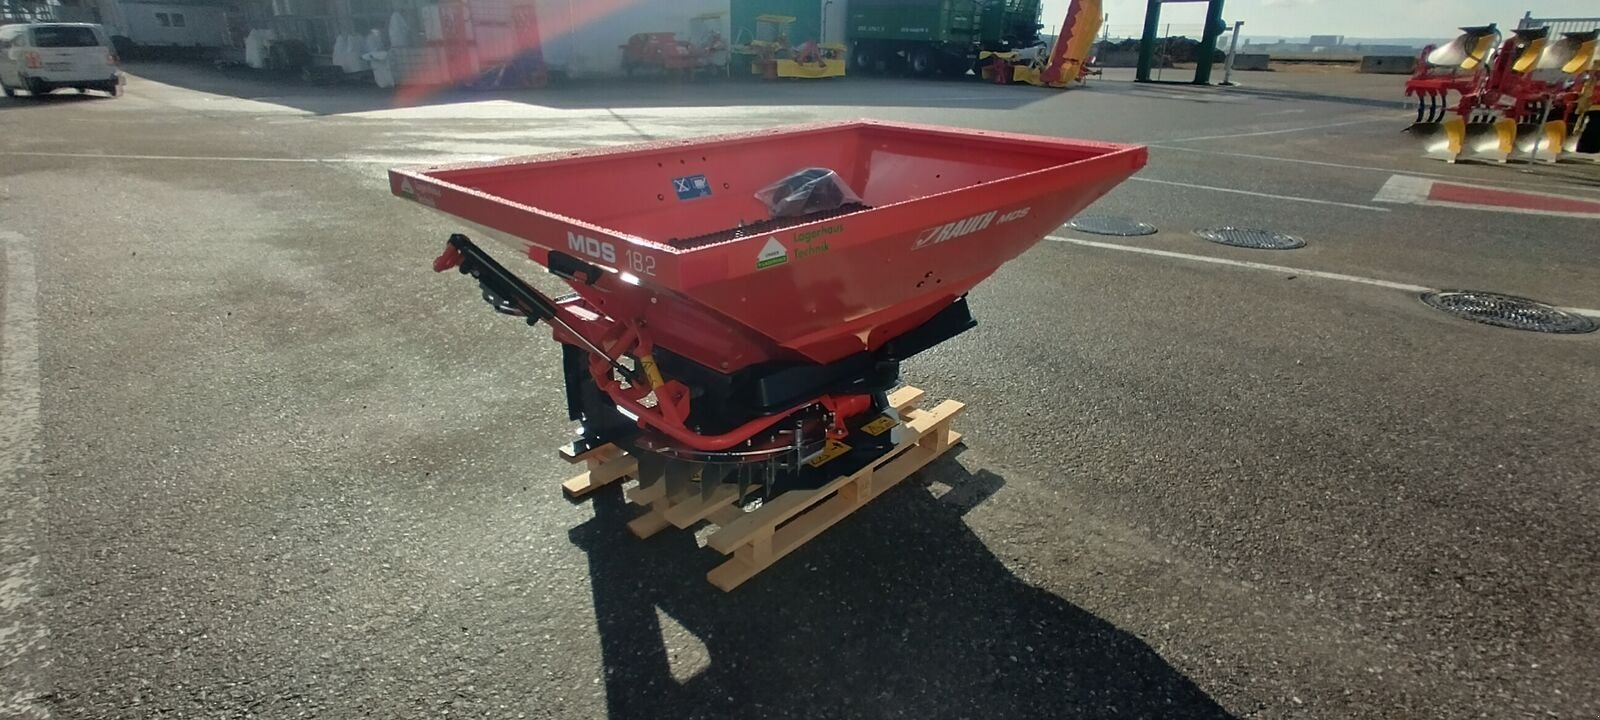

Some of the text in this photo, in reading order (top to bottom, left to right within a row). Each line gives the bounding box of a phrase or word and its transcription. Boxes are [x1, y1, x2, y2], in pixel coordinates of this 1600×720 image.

[793, 224, 843, 243] Lagerhaus
[934, 207, 1031, 243] RAUCH MDS
[567, 231, 656, 277] MDS 18.2
[795, 240, 829, 258] Technik
